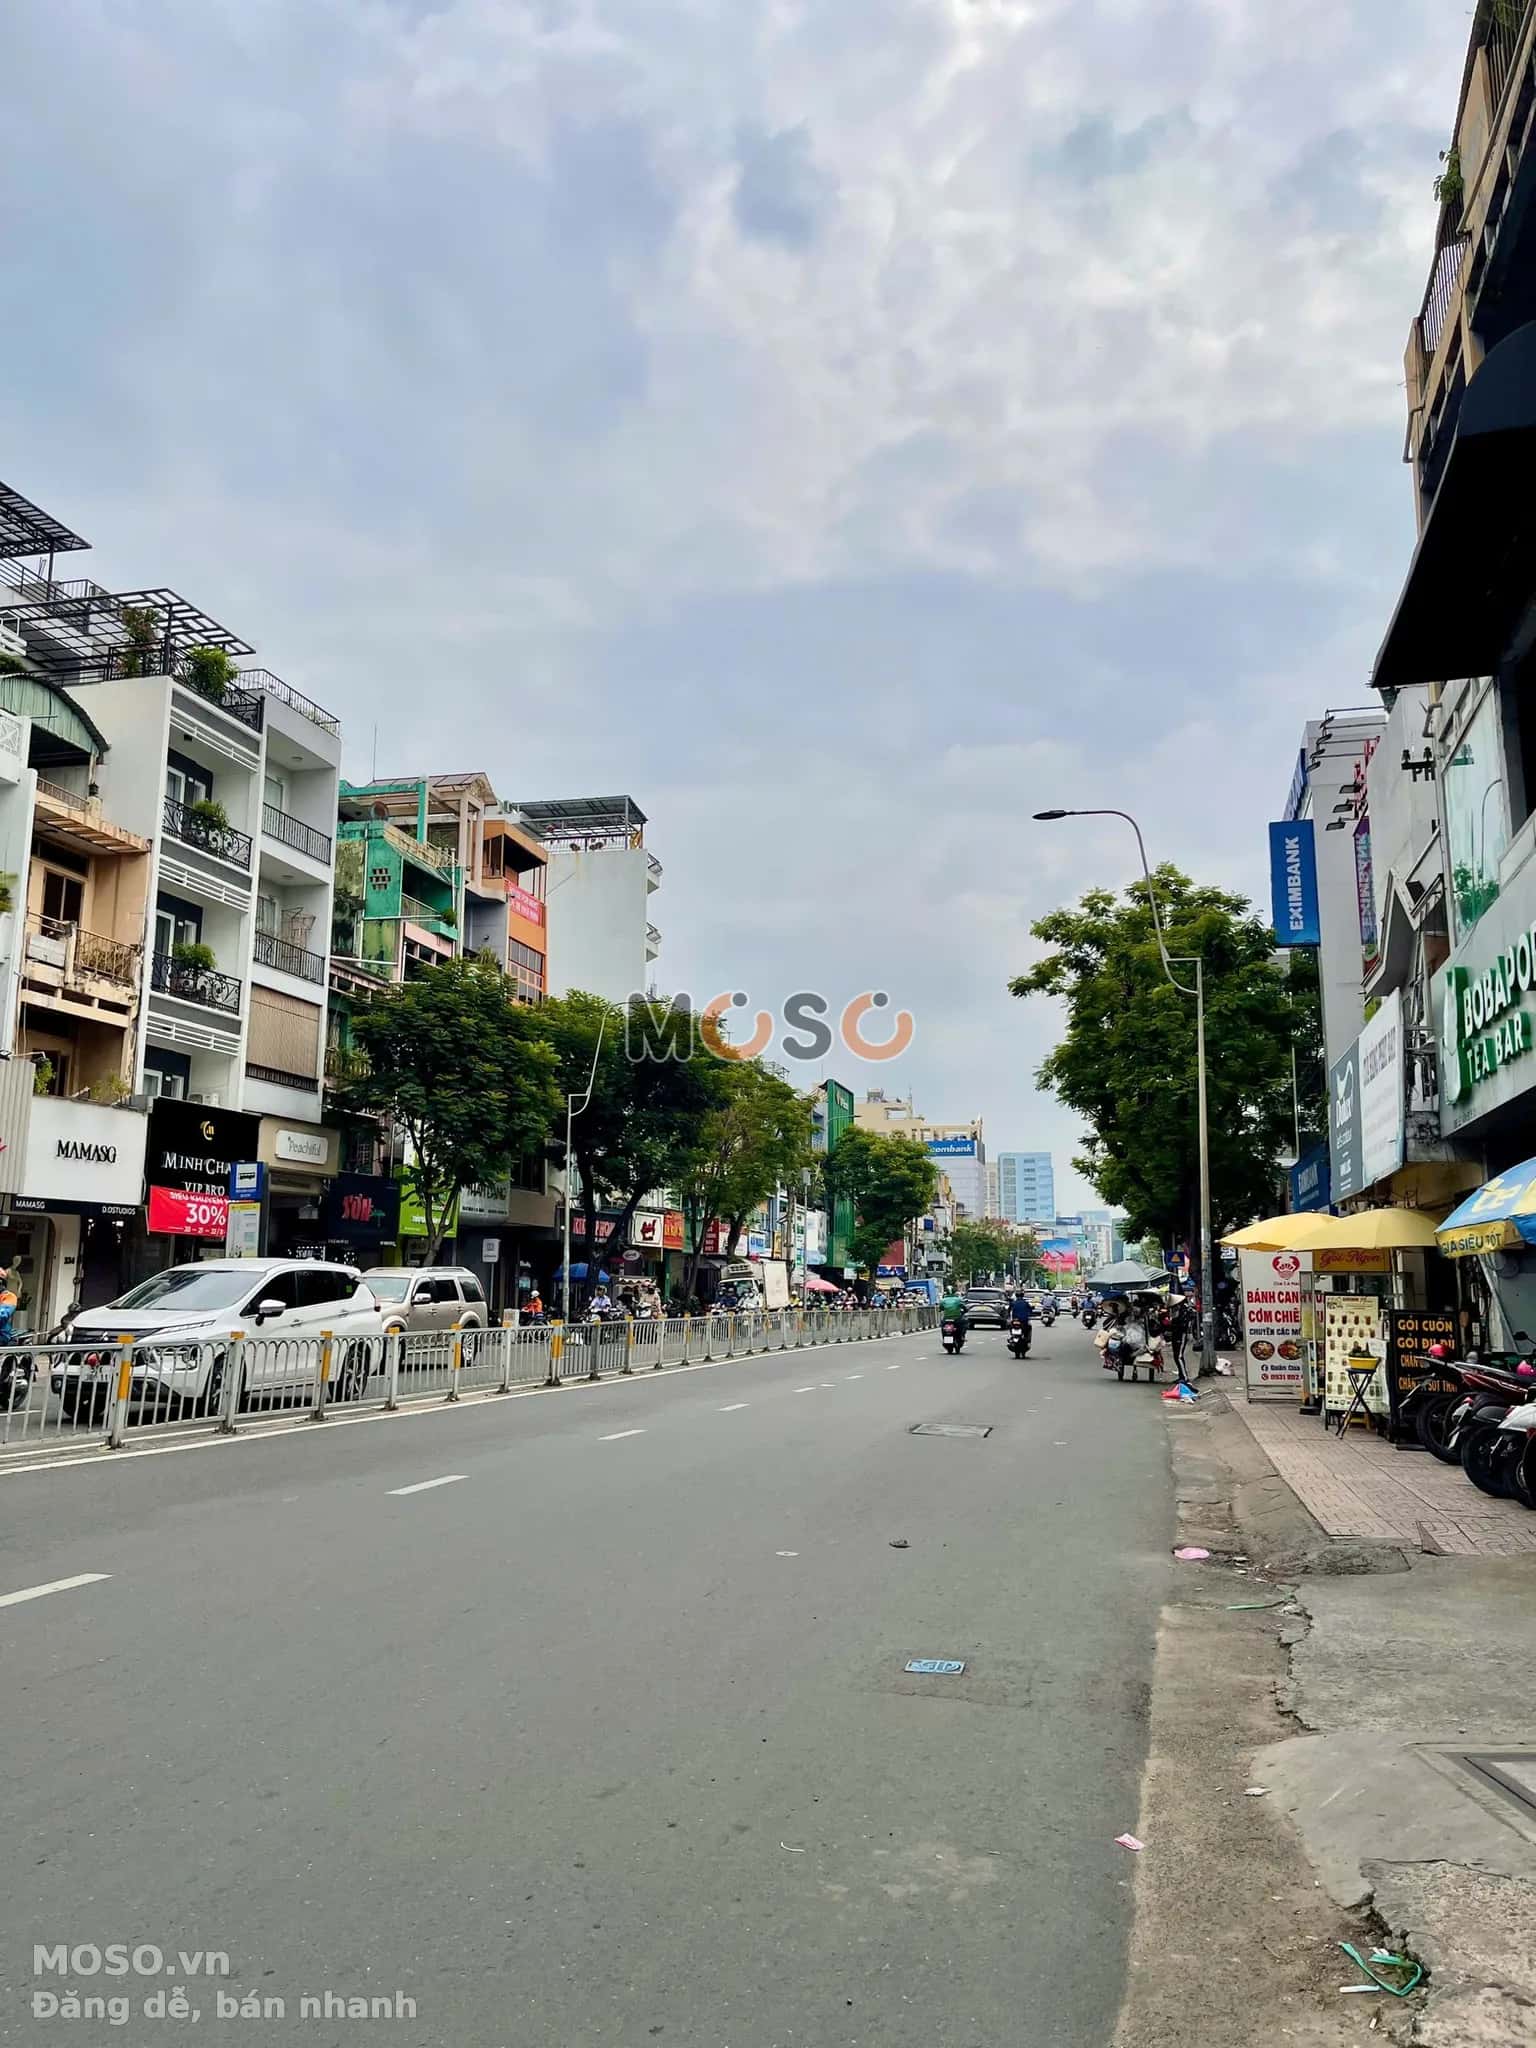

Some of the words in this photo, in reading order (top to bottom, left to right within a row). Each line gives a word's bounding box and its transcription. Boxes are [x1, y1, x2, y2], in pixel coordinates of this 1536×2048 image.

[1285, 836, 1304, 931] EXIMBANK
[1467, 1041, 1490, 1084] TEA
[1496, 1011, 1524, 1065] BAR
[56, 1139, 117, 1164] MAMASG
[162, 1151, 204, 1172] MINH
[205, 1158, 232, 1175] CHA
[184, 1181, 203, 1193] VIP
[185, 1202, 227, 1226] 30%
[1458, 1232, 1484, 1251] SIÊU
[1247, 1287, 1276, 1304] BÁNH
[1248, 1307, 1273, 1323] CƠM
[1274, 1307, 1300, 1323] CHIÊ
